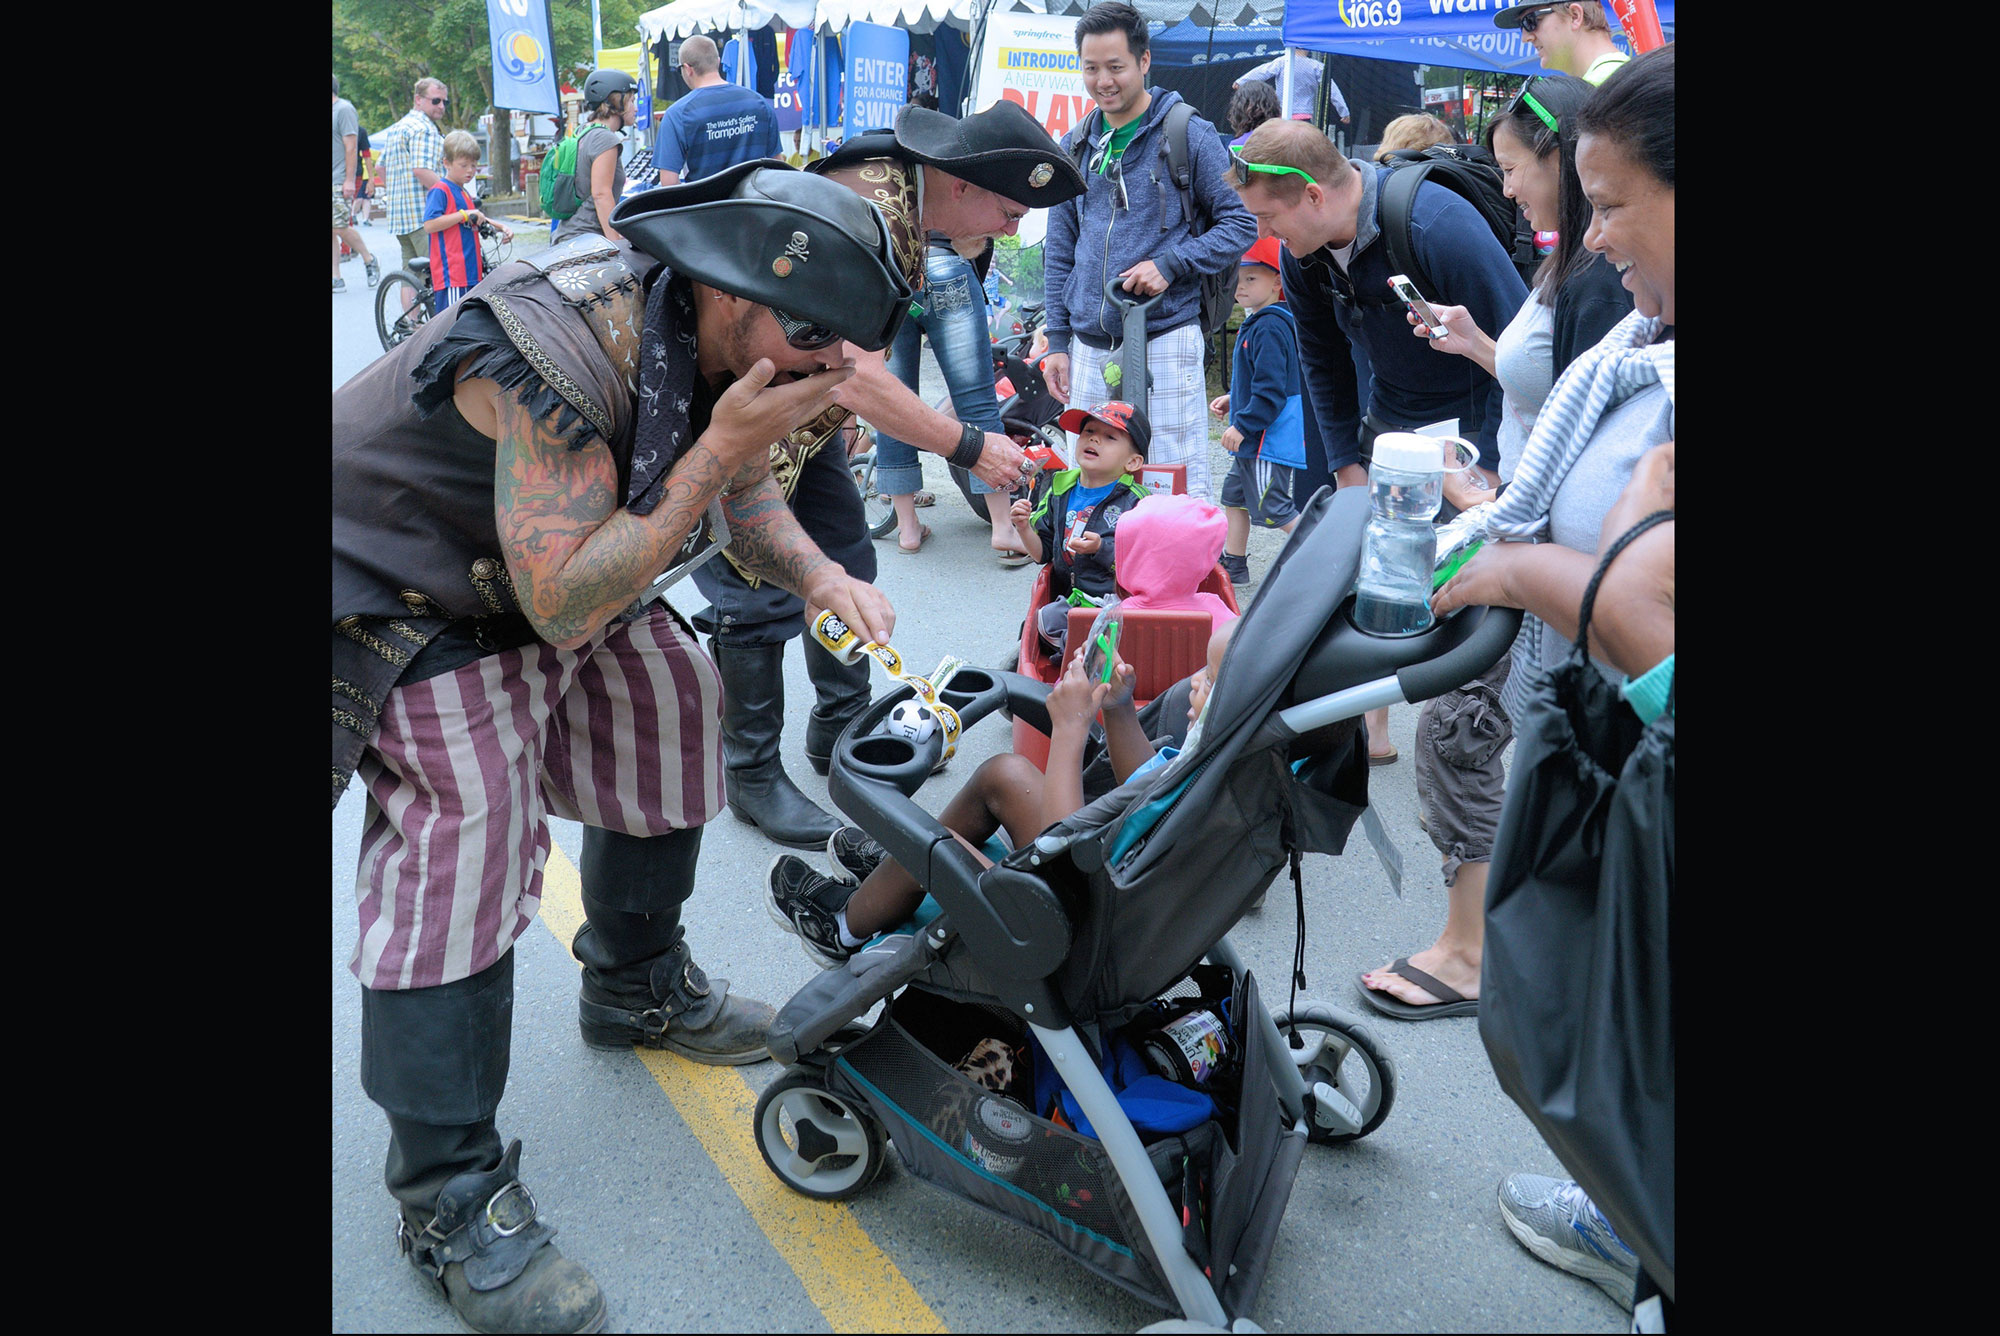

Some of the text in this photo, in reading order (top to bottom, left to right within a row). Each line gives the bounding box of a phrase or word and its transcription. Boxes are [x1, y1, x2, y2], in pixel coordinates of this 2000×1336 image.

[1347, 0, 1402, 28] 106.9
[1013, 28, 1062, 39] springfree
[1007, 51, 1083, 71] INTRODUCI
[854, 57, 905, 87] ENTER
[1004, 71, 1014, 85] A
[1015, 73, 1048, 88] NEW
[1049, 75, 1078, 91] WAY
[853, 86, 904, 102] FOR A CHANCE
[706, 114, 757, 130] The World's Safest
[706, 122, 755, 141] Trampoline
